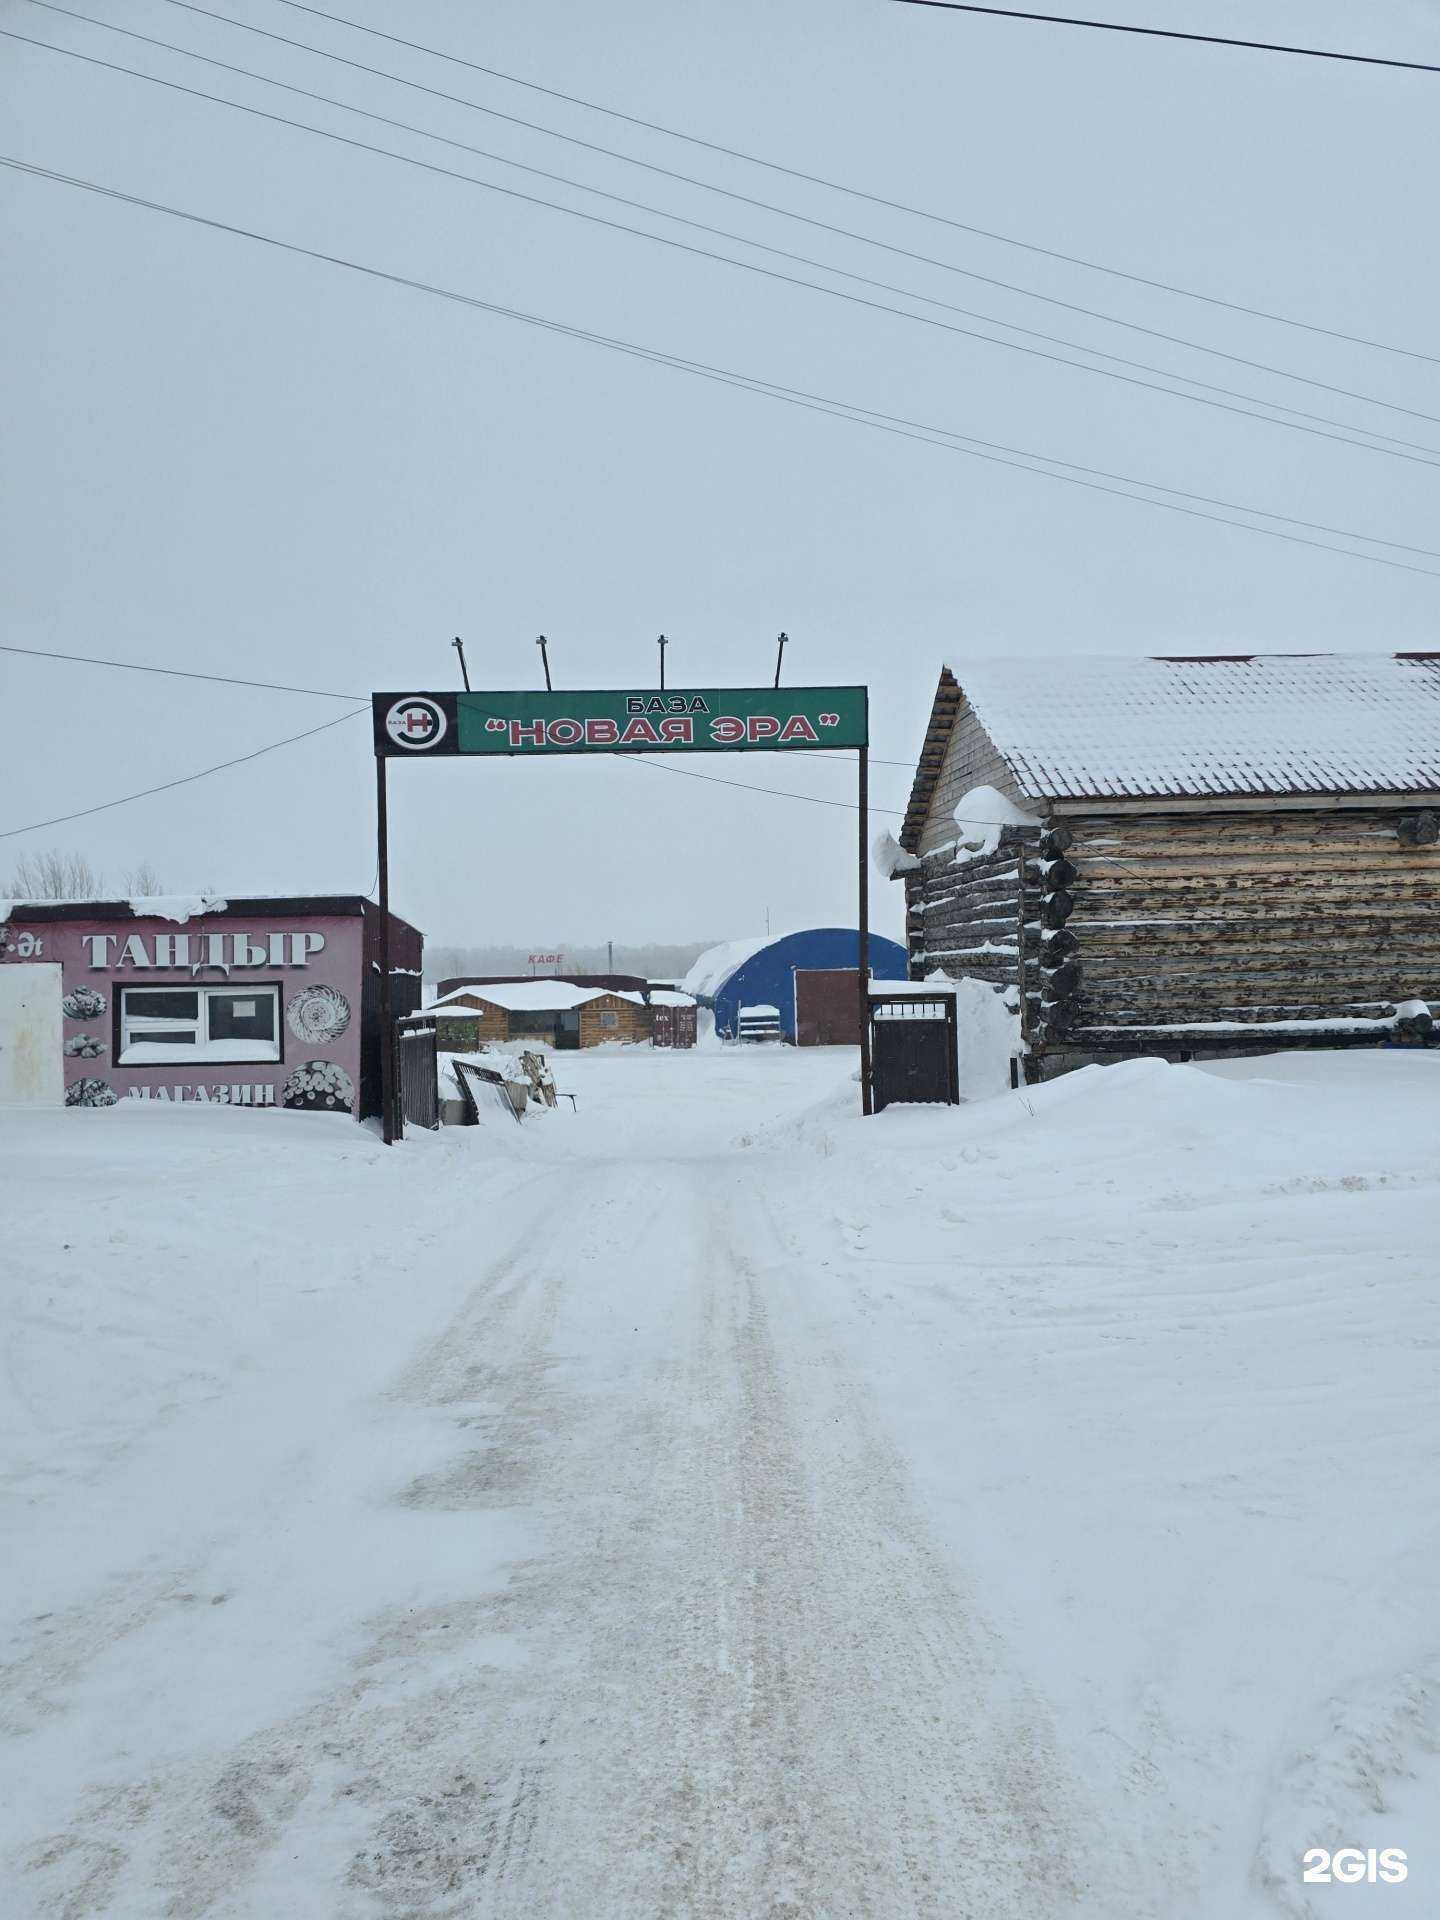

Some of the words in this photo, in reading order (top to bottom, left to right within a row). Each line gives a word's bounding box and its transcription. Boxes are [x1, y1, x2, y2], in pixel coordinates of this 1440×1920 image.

[626, 696, 710, 714] БАЗА
[82, 932, 325, 976] ТАНДЫР
[528, 954, 566, 964] КАФЕ
[128, 1084, 275, 1104] МАГАЗИН
